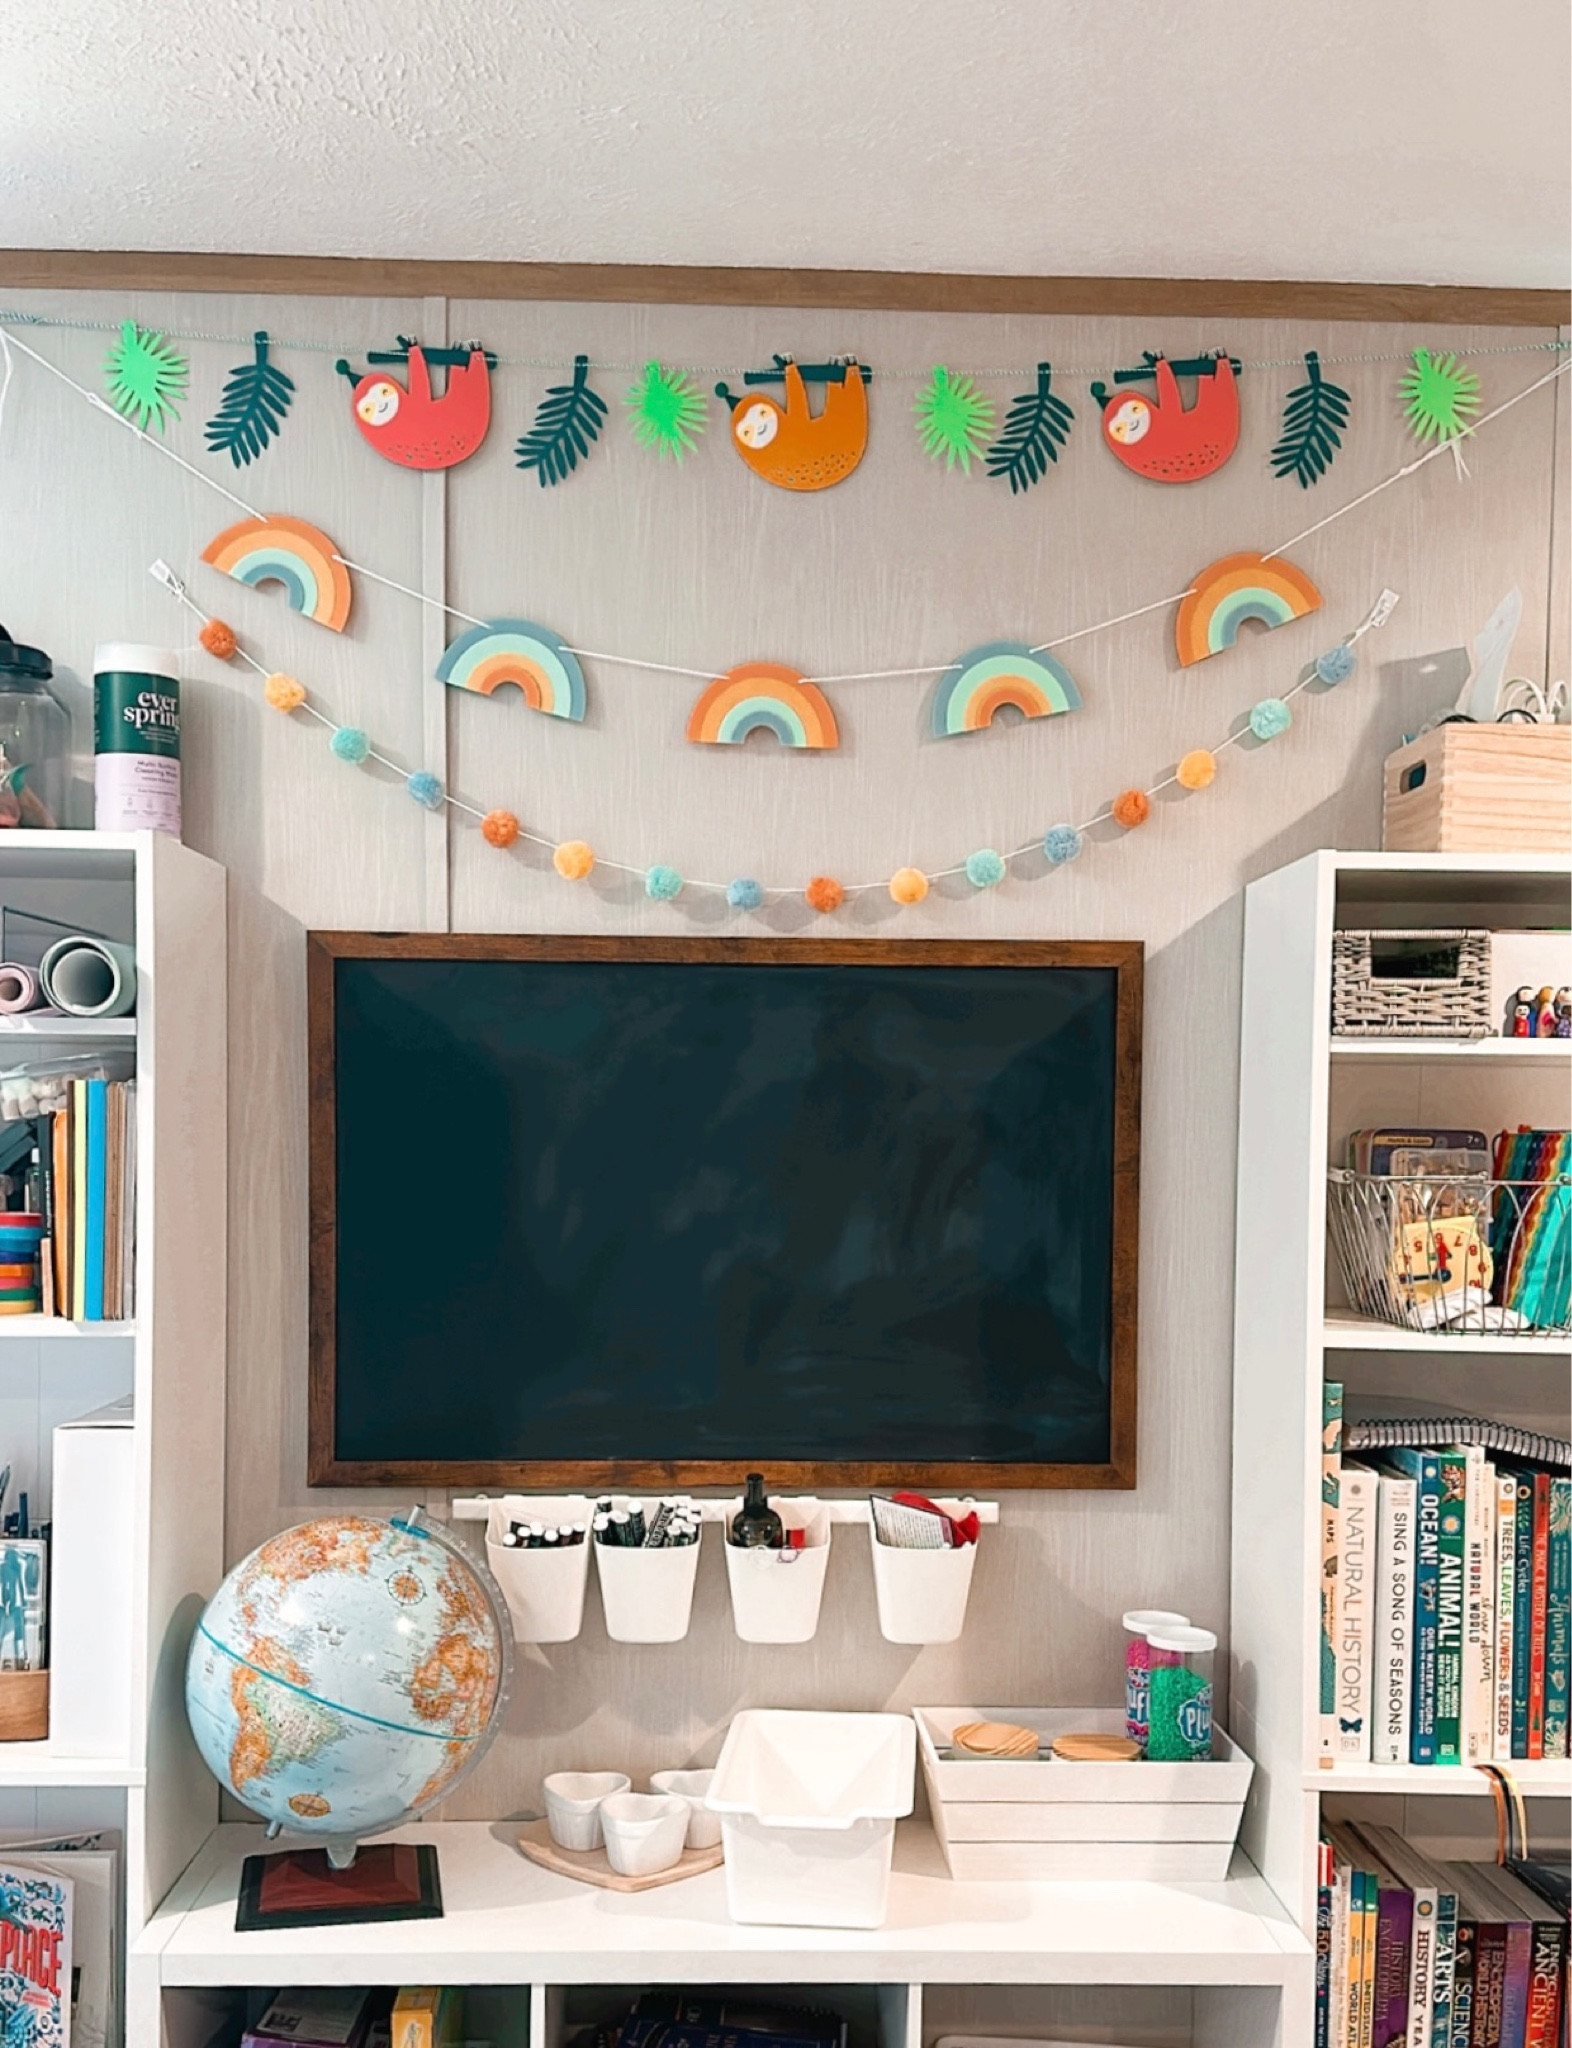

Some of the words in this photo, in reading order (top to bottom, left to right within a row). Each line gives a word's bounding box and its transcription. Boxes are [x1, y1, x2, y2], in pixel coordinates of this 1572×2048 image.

[138, 692, 176, 712] ever
[1325, 1519, 1335, 1543] MAPS
[1394, 1512, 1408, 1551] SING
[1420, 1493, 1439, 1565] OCEAN!
[1500, 1520, 1514, 1565] TREES,
[1518, 1535, 1530, 1555] Life
[1343, 1507, 1365, 1611] NATURAL
[1393, 1557, 1406, 1566] A
[1470, 1542, 1482, 1597] NATURAL
[1516, 1558, 1530, 1594] Cycles
[1391, 1573, 1406, 1621] SONG
[1438, 1553, 1461, 1647] ANIMAL!
[1499, 1566, 1512, 1619] LEAVES,
[1390, 1628, 1405, 1651] OF
[1426, 1627, 1436, 1650] OUR
[1469, 1601, 1481, 1644] WORLD
[1548, 1593, 1570, 1665] Animals
[1341, 1618, 1363, 1713] HISTORY
[1425, 1652, 1435, 1694] WATERY
[1480, 1640, 1494, 1683] down
[1500, 1621, 1511, 1681] FLOWERS
[1388, 1658, 1404, 1736] SEASONS
[1499, 1682, 1509, 1692] &
[1424, 1696, 1434, 1735] WORLD
[1498, 1694, 1510, 1736] SEEDS
[0, 1919, 64, 1998] PLACE
[1317, 1930, 1331, 1953] 50
[1375, 1918, 1392, 2022] ENCYCLOPEDIA
[1390, 1940, 1405, 1998] HISTORY
[1413, 1930, 1430, 2009] HISTORY
[1432, 1942, 1455, 2003] ARTS
[1477, 1950, 1492, 1996] WORLD
[1530, 1942, 1551, 2028] ANCIENT
[1349, 1981, 1358, 2025] WORLD
[1363, 1979, 1372, 2013] UNITED
[1452, 1983, 1472, 2048] SCIENC
[1486, 1950, 1505, 2047] ENCYCLOPEDIA
[1362, 2014, 1371, 2047] STATES
[1472, 1996, 1489, 2048] HISTORY
